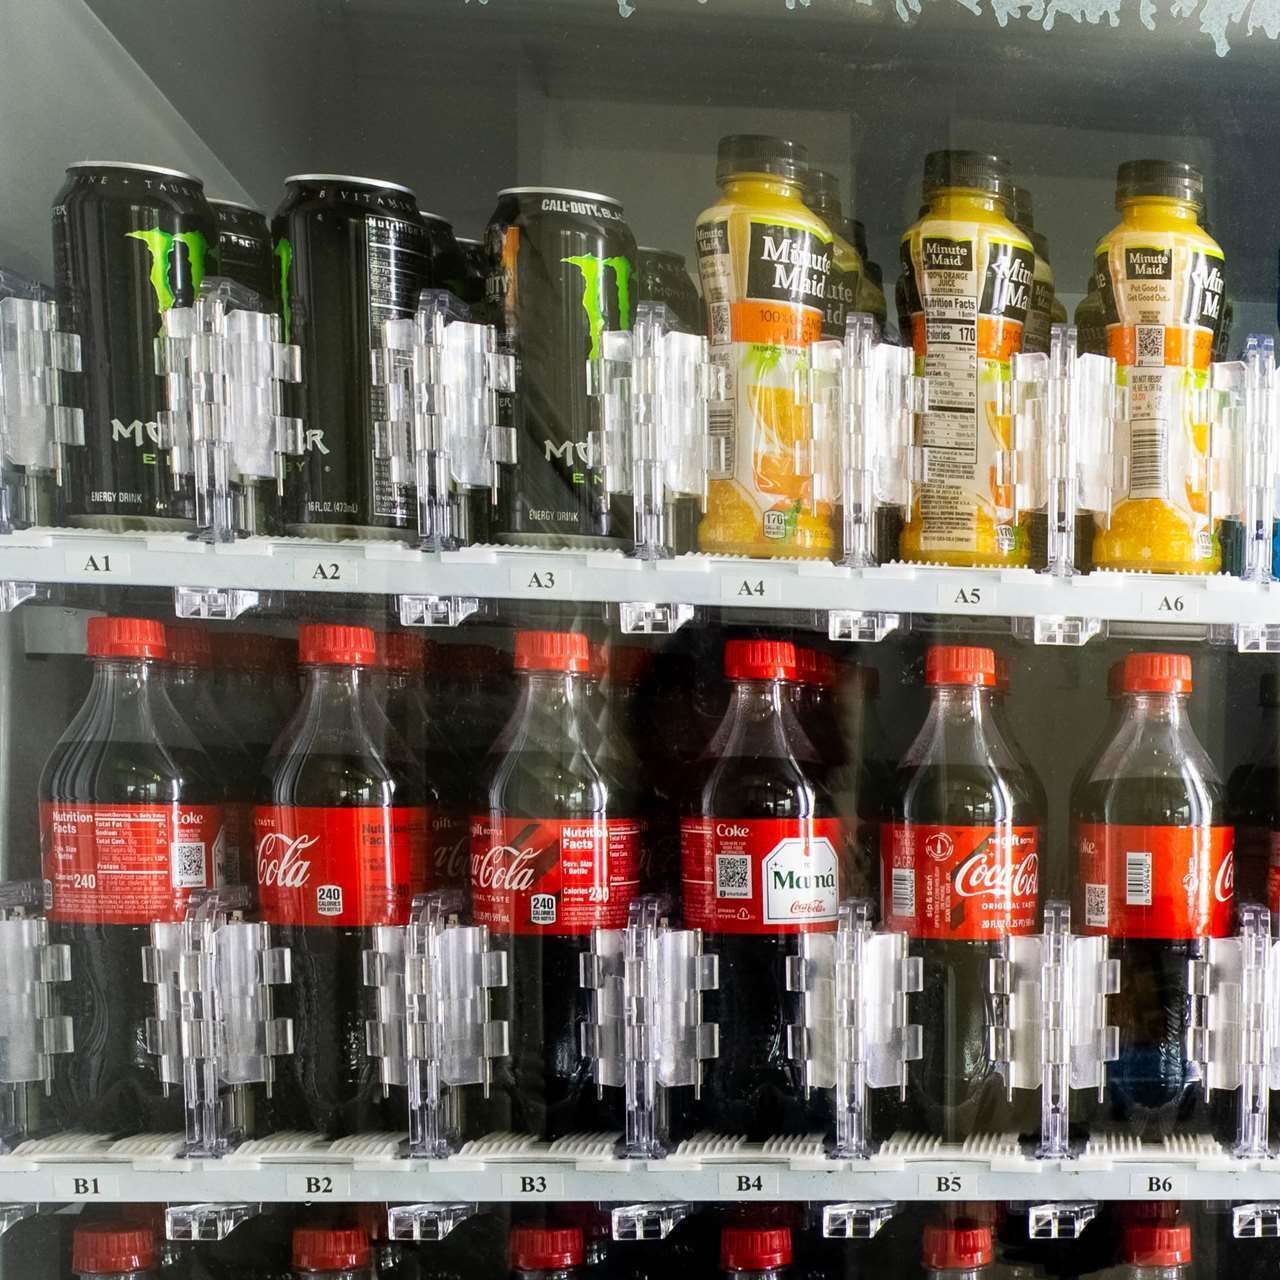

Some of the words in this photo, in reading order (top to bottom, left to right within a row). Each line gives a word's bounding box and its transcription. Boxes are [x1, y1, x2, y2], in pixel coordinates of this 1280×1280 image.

[761, 236, 832, 276] Minute
[926, 243, 968, 256] Minute
[931, 255, 962, 266] Maid
[1129, 253, 1169, 264] Minute
[1135, 264, 1163, 275] Maid
[772, 263, 825, 300] Maid
[959, 328, 976, 341] 170
[91, 491, 117, 503] ENERGY
[119, 492, 142, 503] DRINK
[84, 555, 112, 573] A1
[311, 563, 340, 580] A2
[528, 572, 555, 588] A3
[738, 580, 765, 597] A4
[955, 588, 981, 604] A5
[1159, 596, 1184, 611] A6
[53, 811, 93, 823] Nutrition
[172, 811, 203, 825] Coke
[53, 823, 77, 834] Facts
[716, 823, 750, 837] Coke
[74, 874, 96, 889] 240
[318, 888, 341, 901] 240
[532, 897, 554, 910] 240
[74, 1177, 100, 1195] B1
[306, 1176, 333, 1194] B2
[520, 1176, 547, 1193] B3
[737, 1175, 763, 1192] B4
[937, 1176, 962, 1192] B5
[1148, 1176, 1173, 1192] B6
